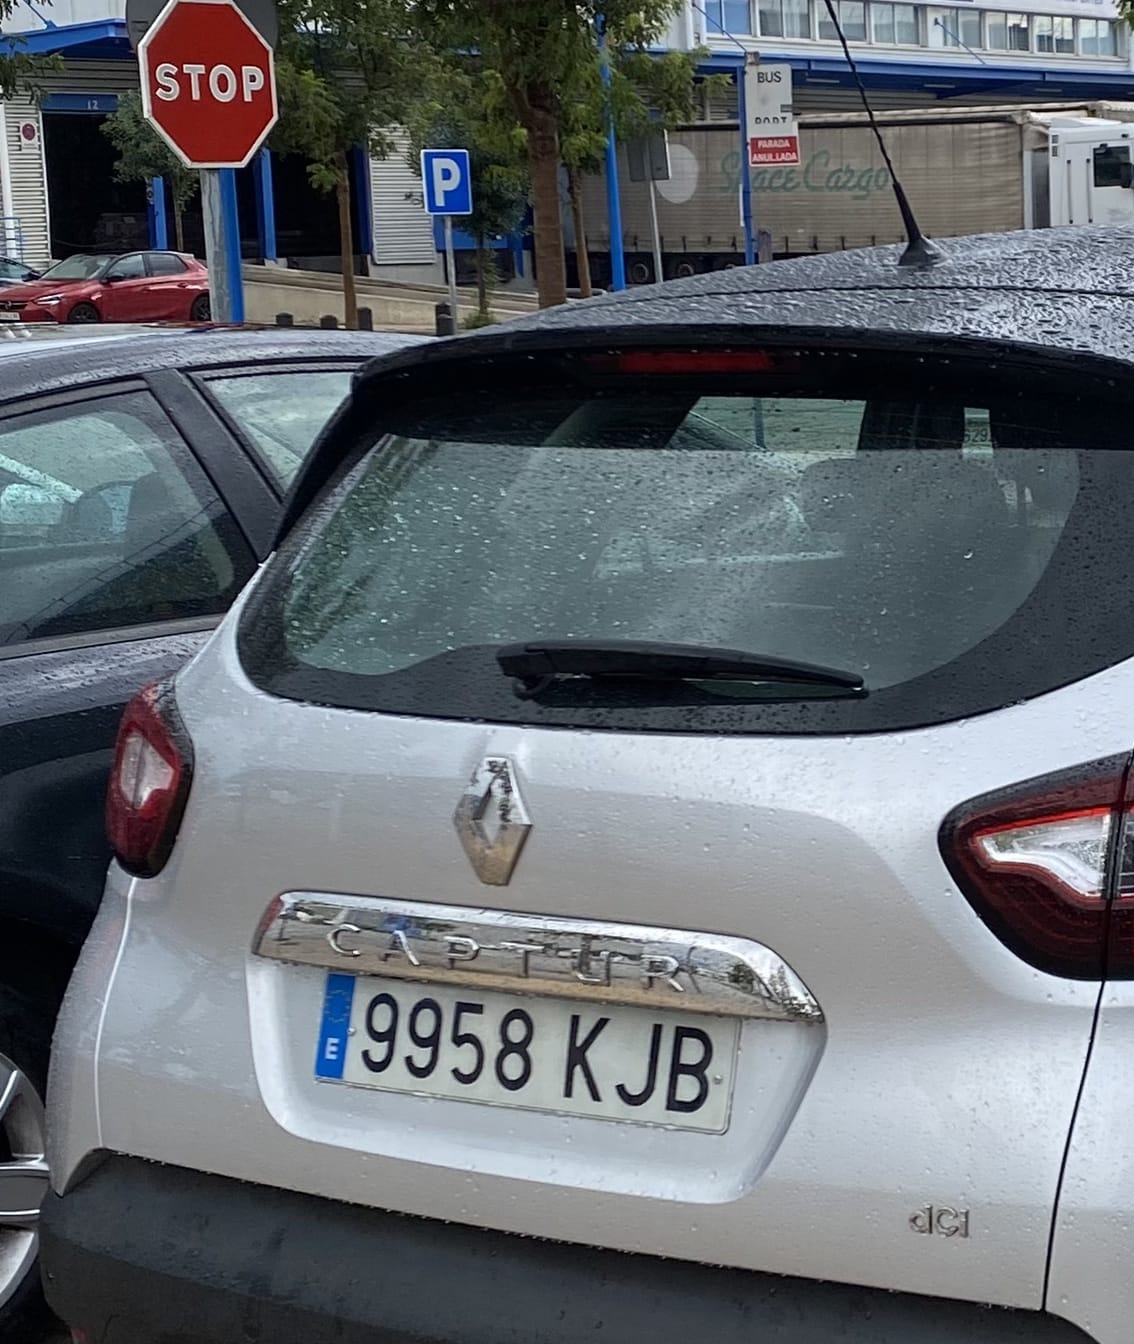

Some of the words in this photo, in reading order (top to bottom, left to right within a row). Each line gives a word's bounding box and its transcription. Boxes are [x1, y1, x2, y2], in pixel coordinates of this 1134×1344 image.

[155, 63, 265, 103] STOP
[757, 71, 782, 83] BUS
[87, 99, 99, 111] 12
[758, 139, 790, 149] PARADA
[432, 158, 461, 206] P
[719, 150, 801, 193] Sace
[803, 150, 890, 199] Cargo
[326, 923, 684, 993] CAPTUR
[325, 1037, 339, 1060] E
[360, 992, 535, 1091] 9958
[563, 1013, 715, 1113] KJB
